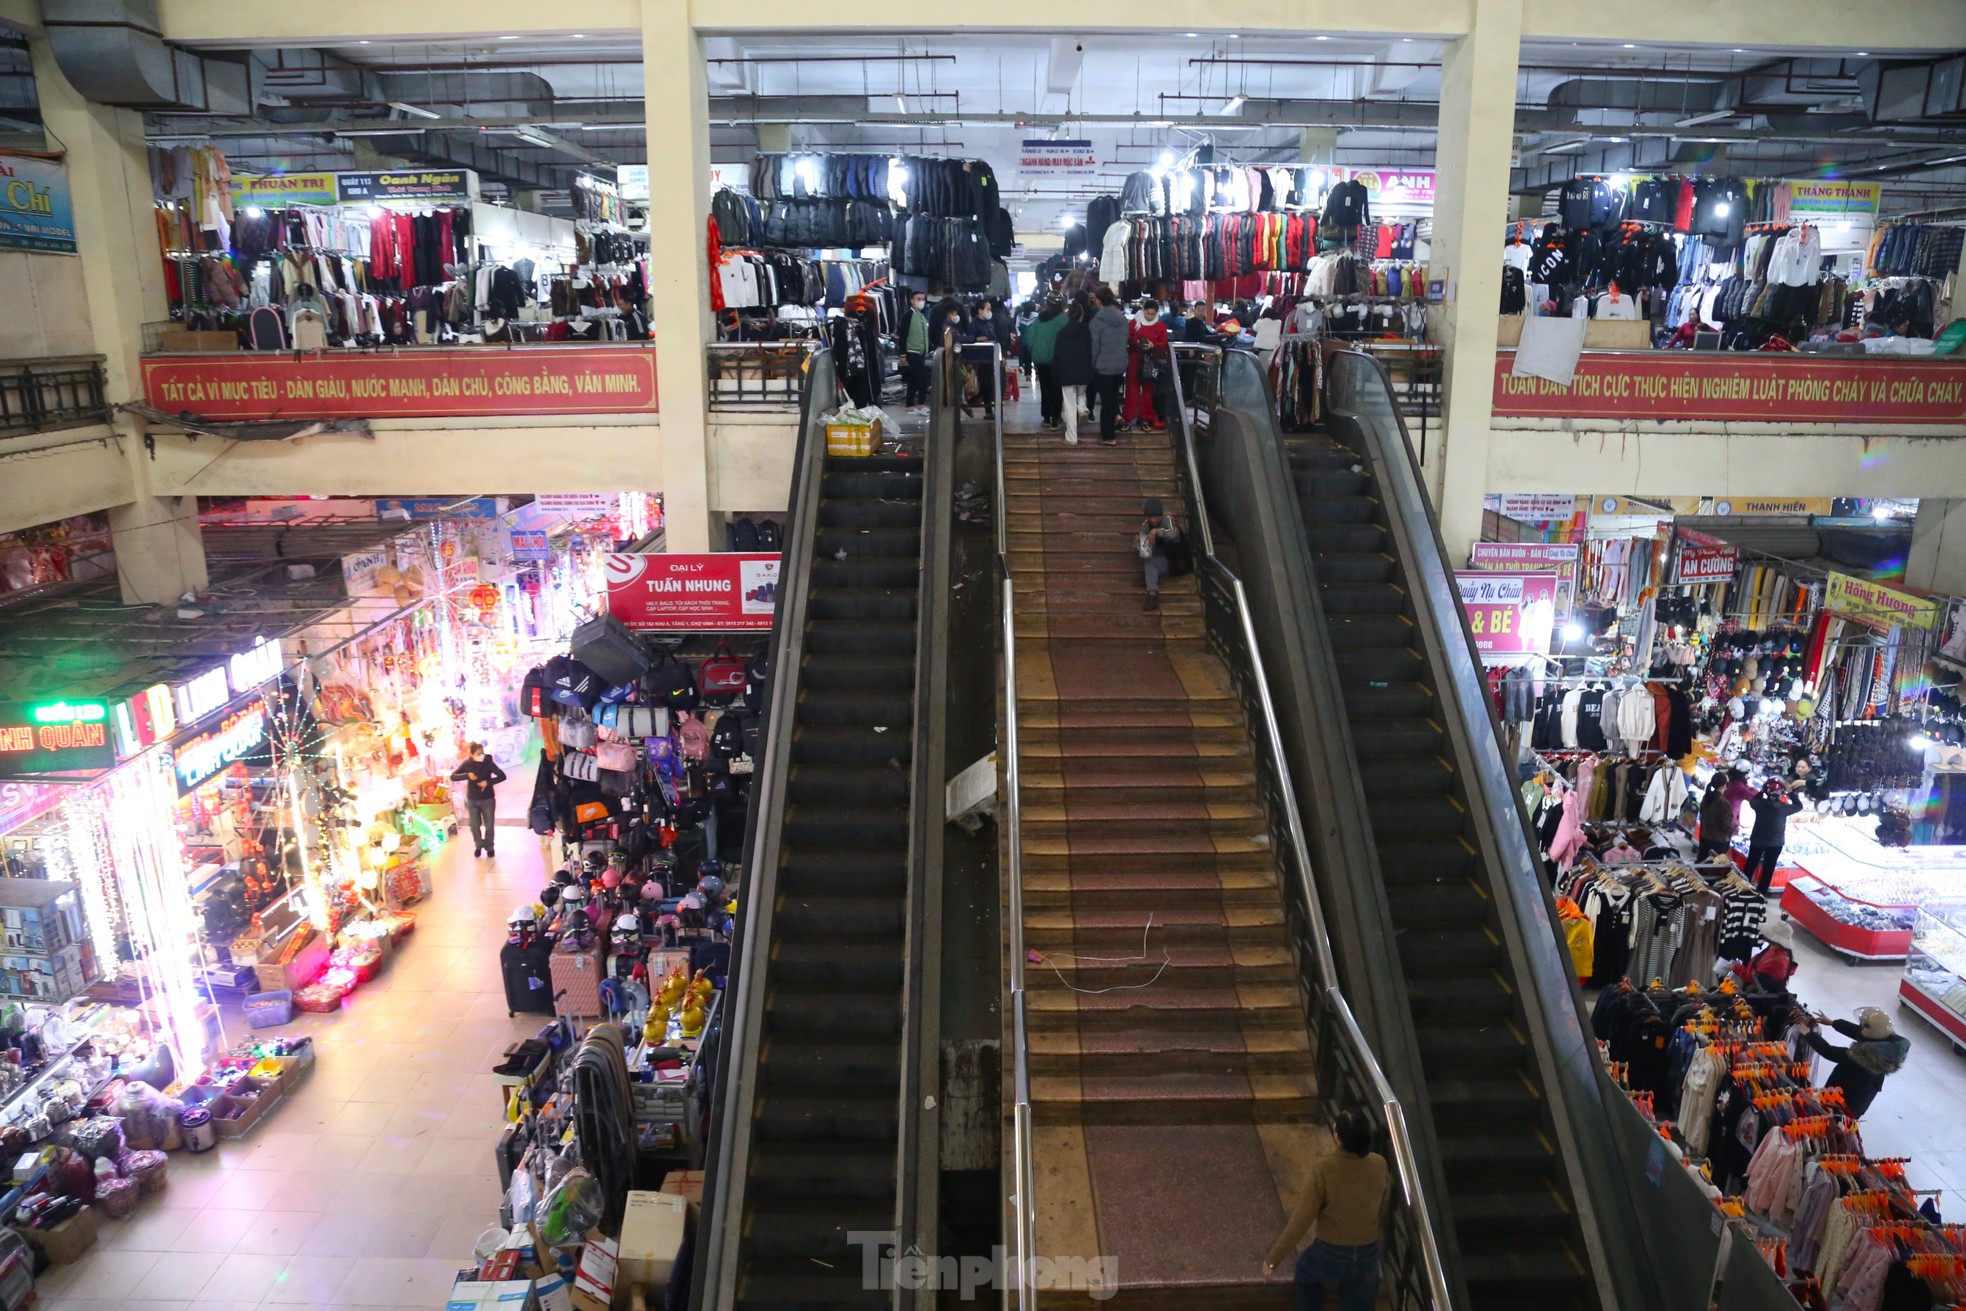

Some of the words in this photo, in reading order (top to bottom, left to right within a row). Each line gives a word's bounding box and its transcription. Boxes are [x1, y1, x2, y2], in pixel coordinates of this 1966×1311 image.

[7, 180, 52, 214] Chí
[162, 375, 185, 401] TẤT
[187, 375, 203, 401] CẢ
[207, 377, 219, 401] VÌ
[222, 379, 249, 406] MỤC
[250, 375, 278, 400] TIÊU
[286, 375, 314, 399] DÂN
[316, 375, 350, 400] GIÀU,
[352, 373, 386, 398] NƯỚC
[389, 377, 431, 403] MẠNH,
[432, 373, 460, 397] DÂN
[462, 369, 492, 398] CHỦ,
[495, 371, 531, 396] CÔNG
[533, 366, 573, 397] BẰNG,
[575, 370, 602, 394] VĂN
[605, 374, 641, 393] MINH.
[1572, 369, 1600, 397] TÍCH
[1603, 373, 1631, 404] CỰC
[1634, 374, 1667, 405] THỰC
[1670, 371, 1699, 405] HIỆN
[1702, 373, 1750, 400] NGHIÊM
[1753, 373, 1786, 407] LUẬT
[1787, 374, 1830, 402] PHÒNG
[1833, 375, 1868, 403] CHÁY
[1870, 376, 1887, 403] VÀ
[1890, 376, 1924, 404] CHỮA
[1928, 376, 1962, 404] CHÁY.
[1746, 503, 1781, 512] THANH
[670, 564, 688, 573] ĐẠI
[1683, 560, 1698, 575] AN
[1700, 554, 1734, 574] CƯỜNG
[646, 577, 682, 592] TUẤN
[685, 580, 731, 592] NHUNG
[1497, 583, 1522, 599] Châu
[1844, 580, 1874, 605] Hồng
[1877, 590, 1917, 620] Hương
[1471, 610, 1485, 634] &
[1490, 605, 1513, 634] BÉ
[39, 719, 107, 752] QUÂN
[115, 683, 176, 758] LED
